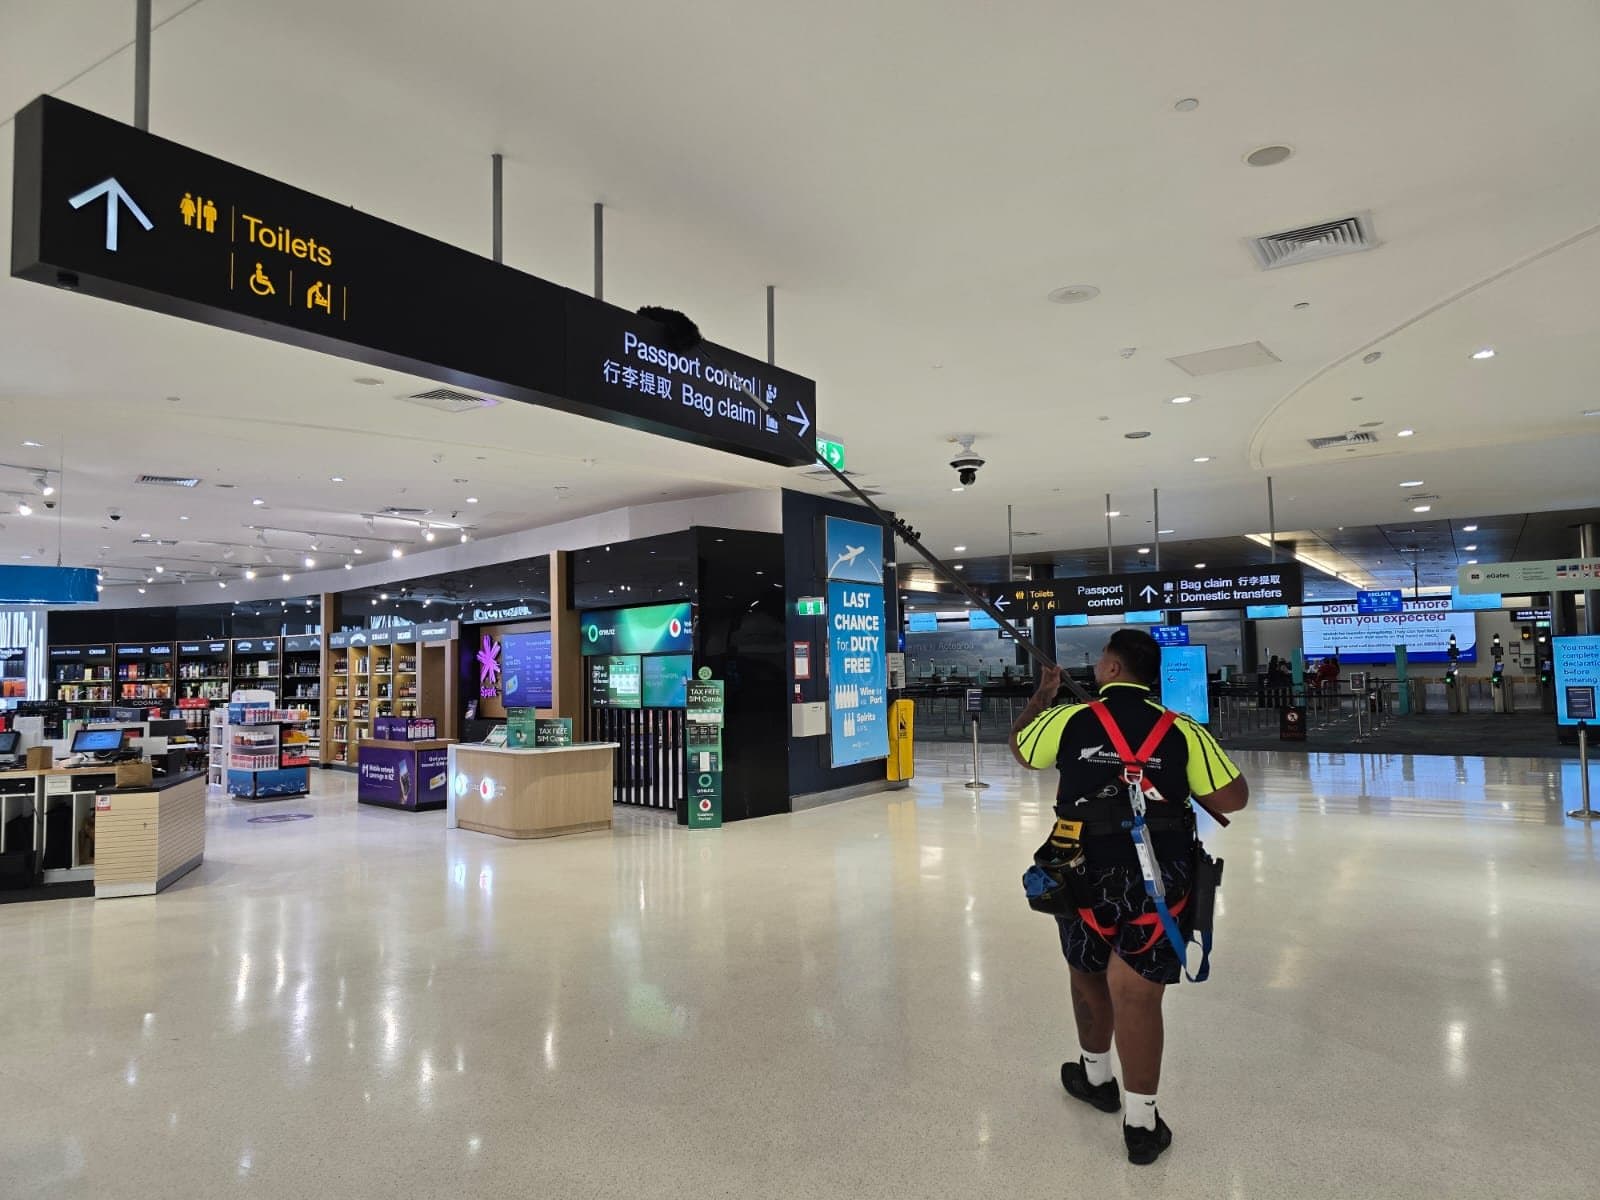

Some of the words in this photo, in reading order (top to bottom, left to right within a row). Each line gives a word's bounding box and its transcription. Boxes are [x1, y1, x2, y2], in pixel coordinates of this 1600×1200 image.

[242, 214, 332, 266] Toilets
[624, 331, 701, 378] Passport
[705, 365, 756, 394] control
[603, 359, 673, 401] 行李提取
[682, 383, 714, 418] Bag
[717, 399, 756, 425] claim
[1077, 584, 1123, 596] Passport
[1180, 580, 1201, 590] Bag
[1204, 578, 1233, 588] claim
[843, 591, 870, 608] LAST
[1030, 590, 1054, 598] Toilets
[1180, 591, 1231, 602] Domestic
[1233, 588, 1282, 599] transfers
[1087, 597, 1123, 607] control
[1322, 604, 1355, 613] Don't
[834, 613, 880, 631] CHANCE
[1323, 616, 1352, 625] than
[1356, 615, 1379, 626] you
[1383, 613, 1446, 625] expected
[837, 637, 848, 651] for
[850, 636, 879, 652] DUTY
[844, 657, 871, 674] FREE
[480, 686, 497, 698] Spark
[860, 687, 875, 696] Wine
[870, 695, 883, 704] Port
[857, 712, 876, 723] Spirits
[553, 727, 568, 735] FREE
